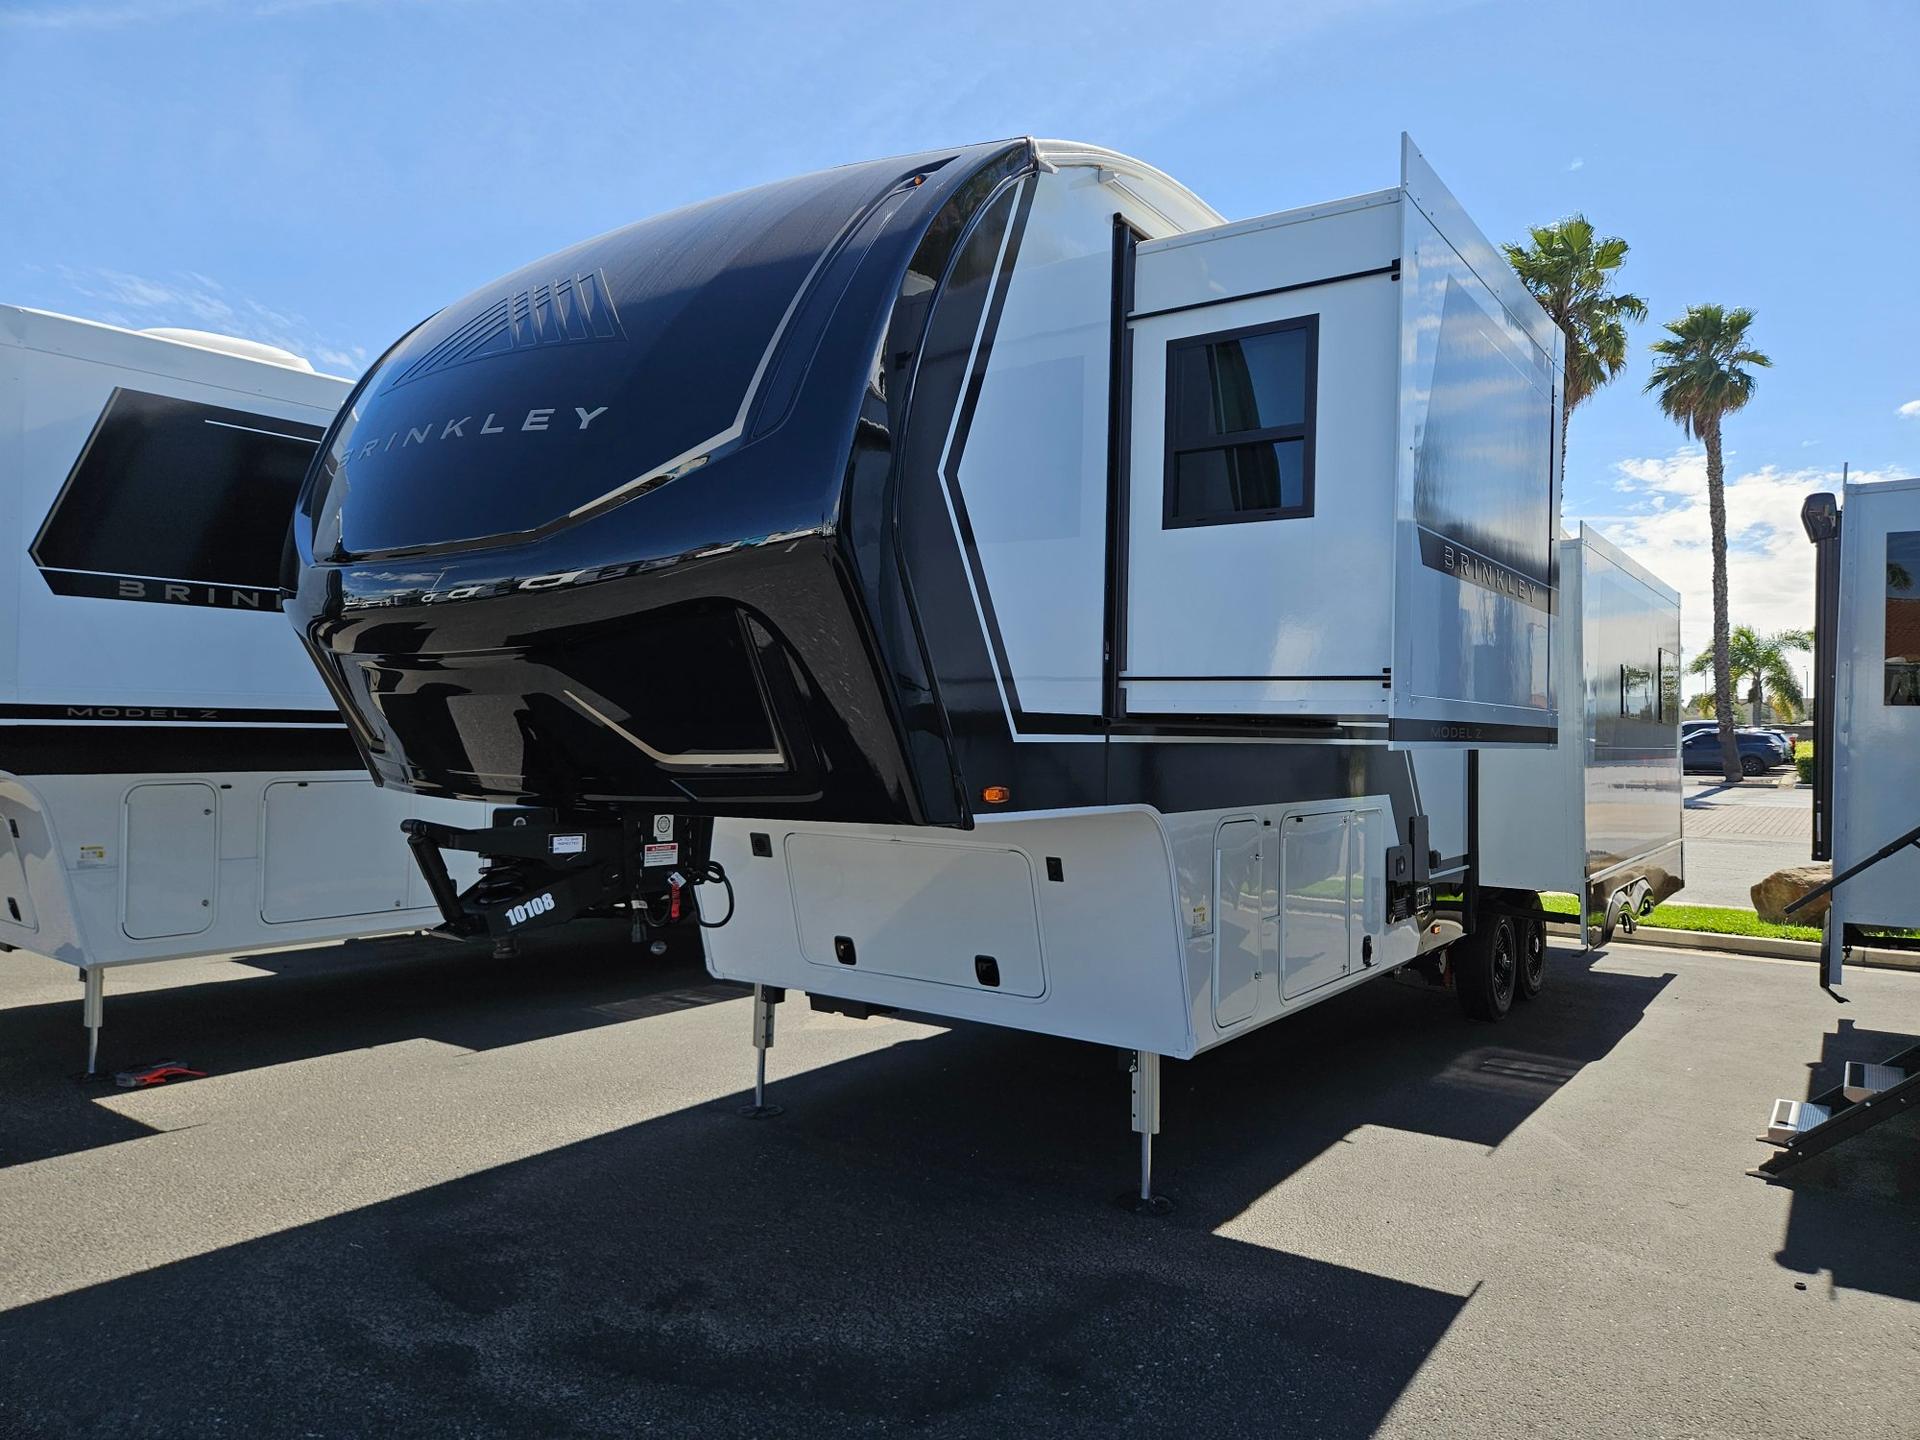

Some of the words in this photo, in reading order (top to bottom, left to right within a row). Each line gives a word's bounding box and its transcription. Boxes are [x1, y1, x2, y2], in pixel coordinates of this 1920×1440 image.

[337, 406, 609, 469] BRINKLEY
[1444, 545, 1536, 603] BRINKLEY
[67, 707, 189, 718] MODEL
[200, 709, 217, 719] Z
[1431, 726, 1473, 739] MODEL
[504, 893, 556, 926] 10108
